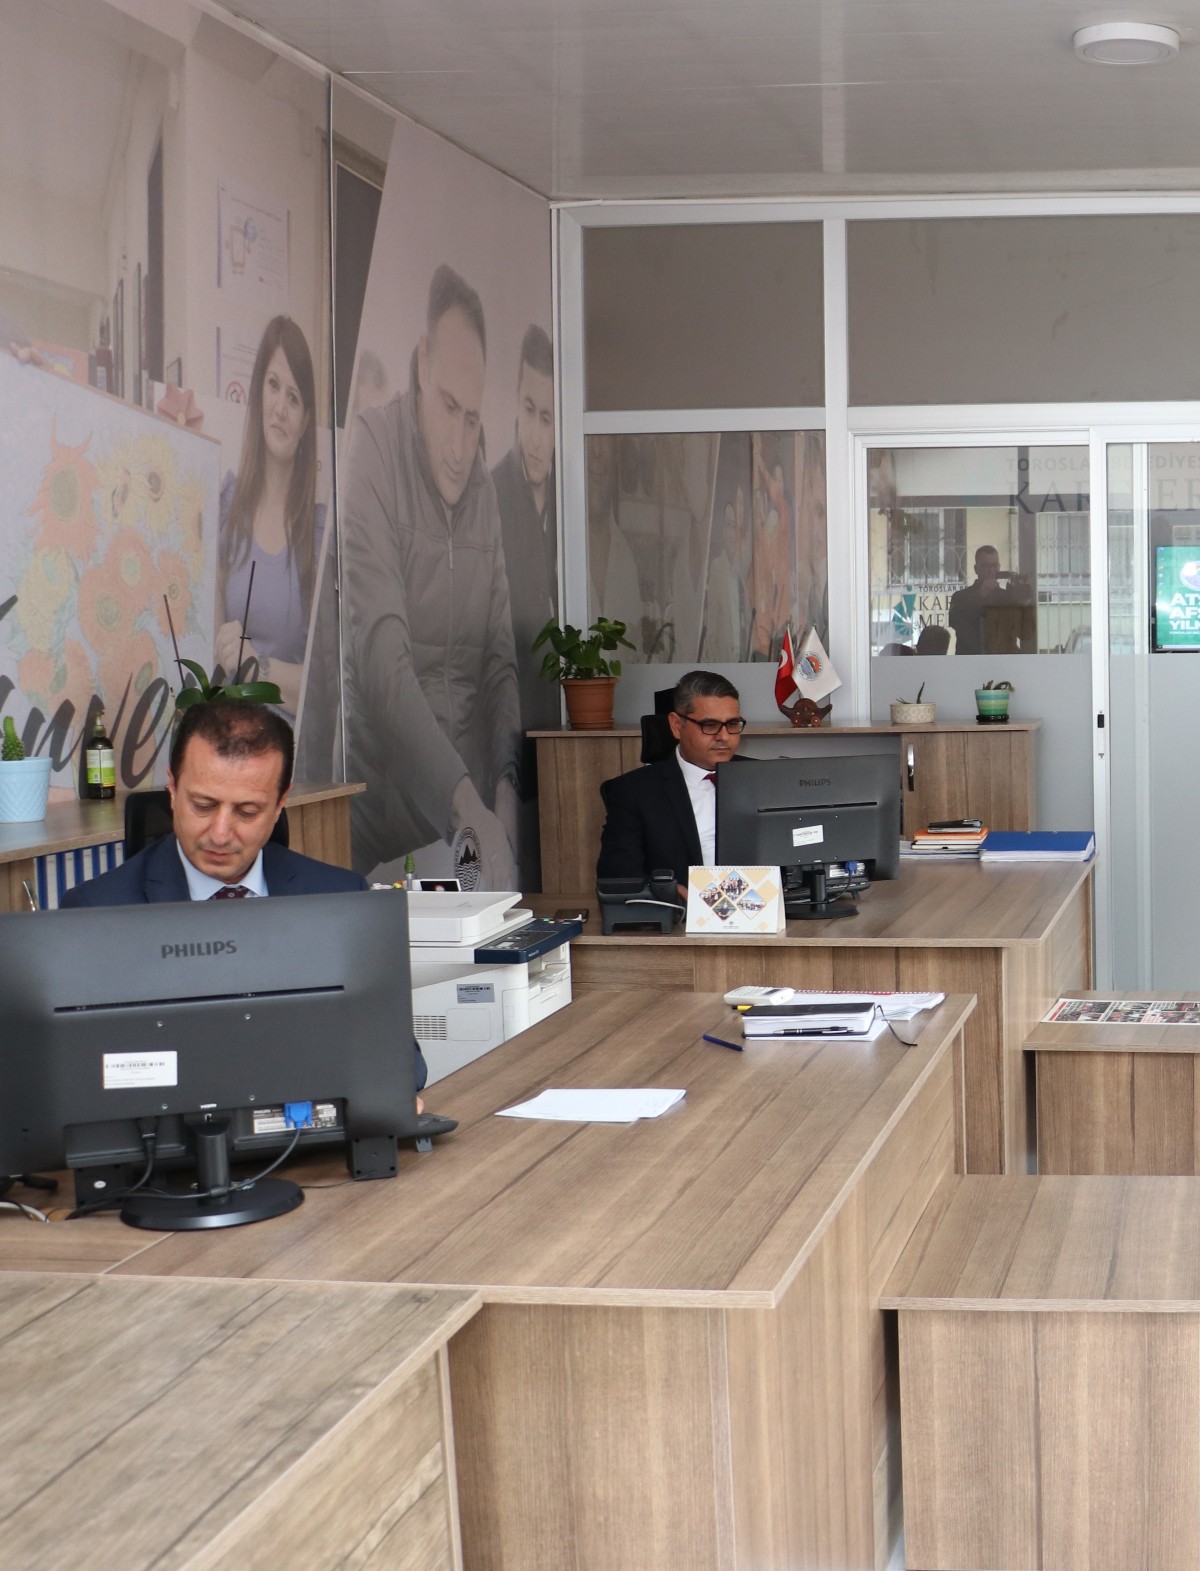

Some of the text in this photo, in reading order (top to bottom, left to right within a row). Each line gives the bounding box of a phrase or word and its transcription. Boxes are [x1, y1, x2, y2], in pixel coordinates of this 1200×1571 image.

[1006, 457, 1090, 472] TOROSLA
[800, 778, 832, 787] PHILIPS
[161, 940, 237, 959] PHILIPS
